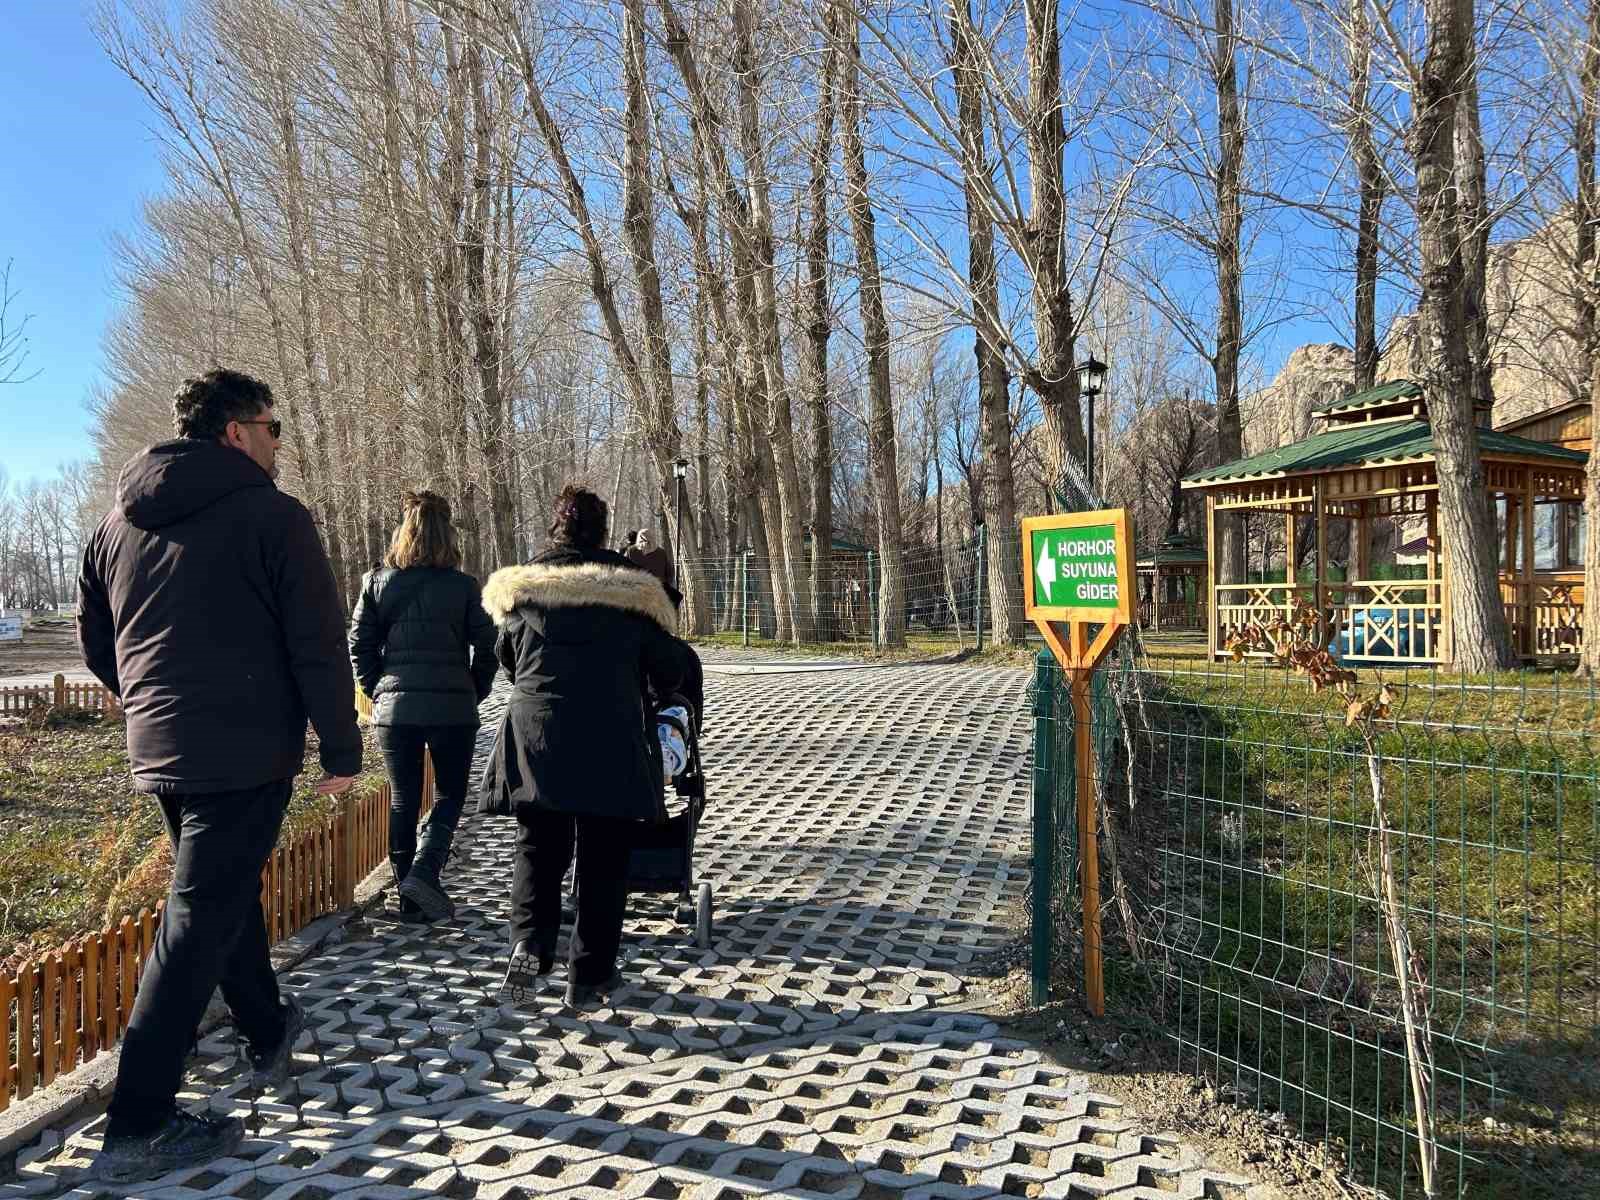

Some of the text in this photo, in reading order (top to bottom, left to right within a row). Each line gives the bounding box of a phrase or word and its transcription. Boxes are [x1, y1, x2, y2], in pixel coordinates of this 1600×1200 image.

[1058, 540, 1116, 557] HORHOR
[1062, 562, 1118, 578] SUYUNA
[1076, 581, 1119, 600] GİDER
